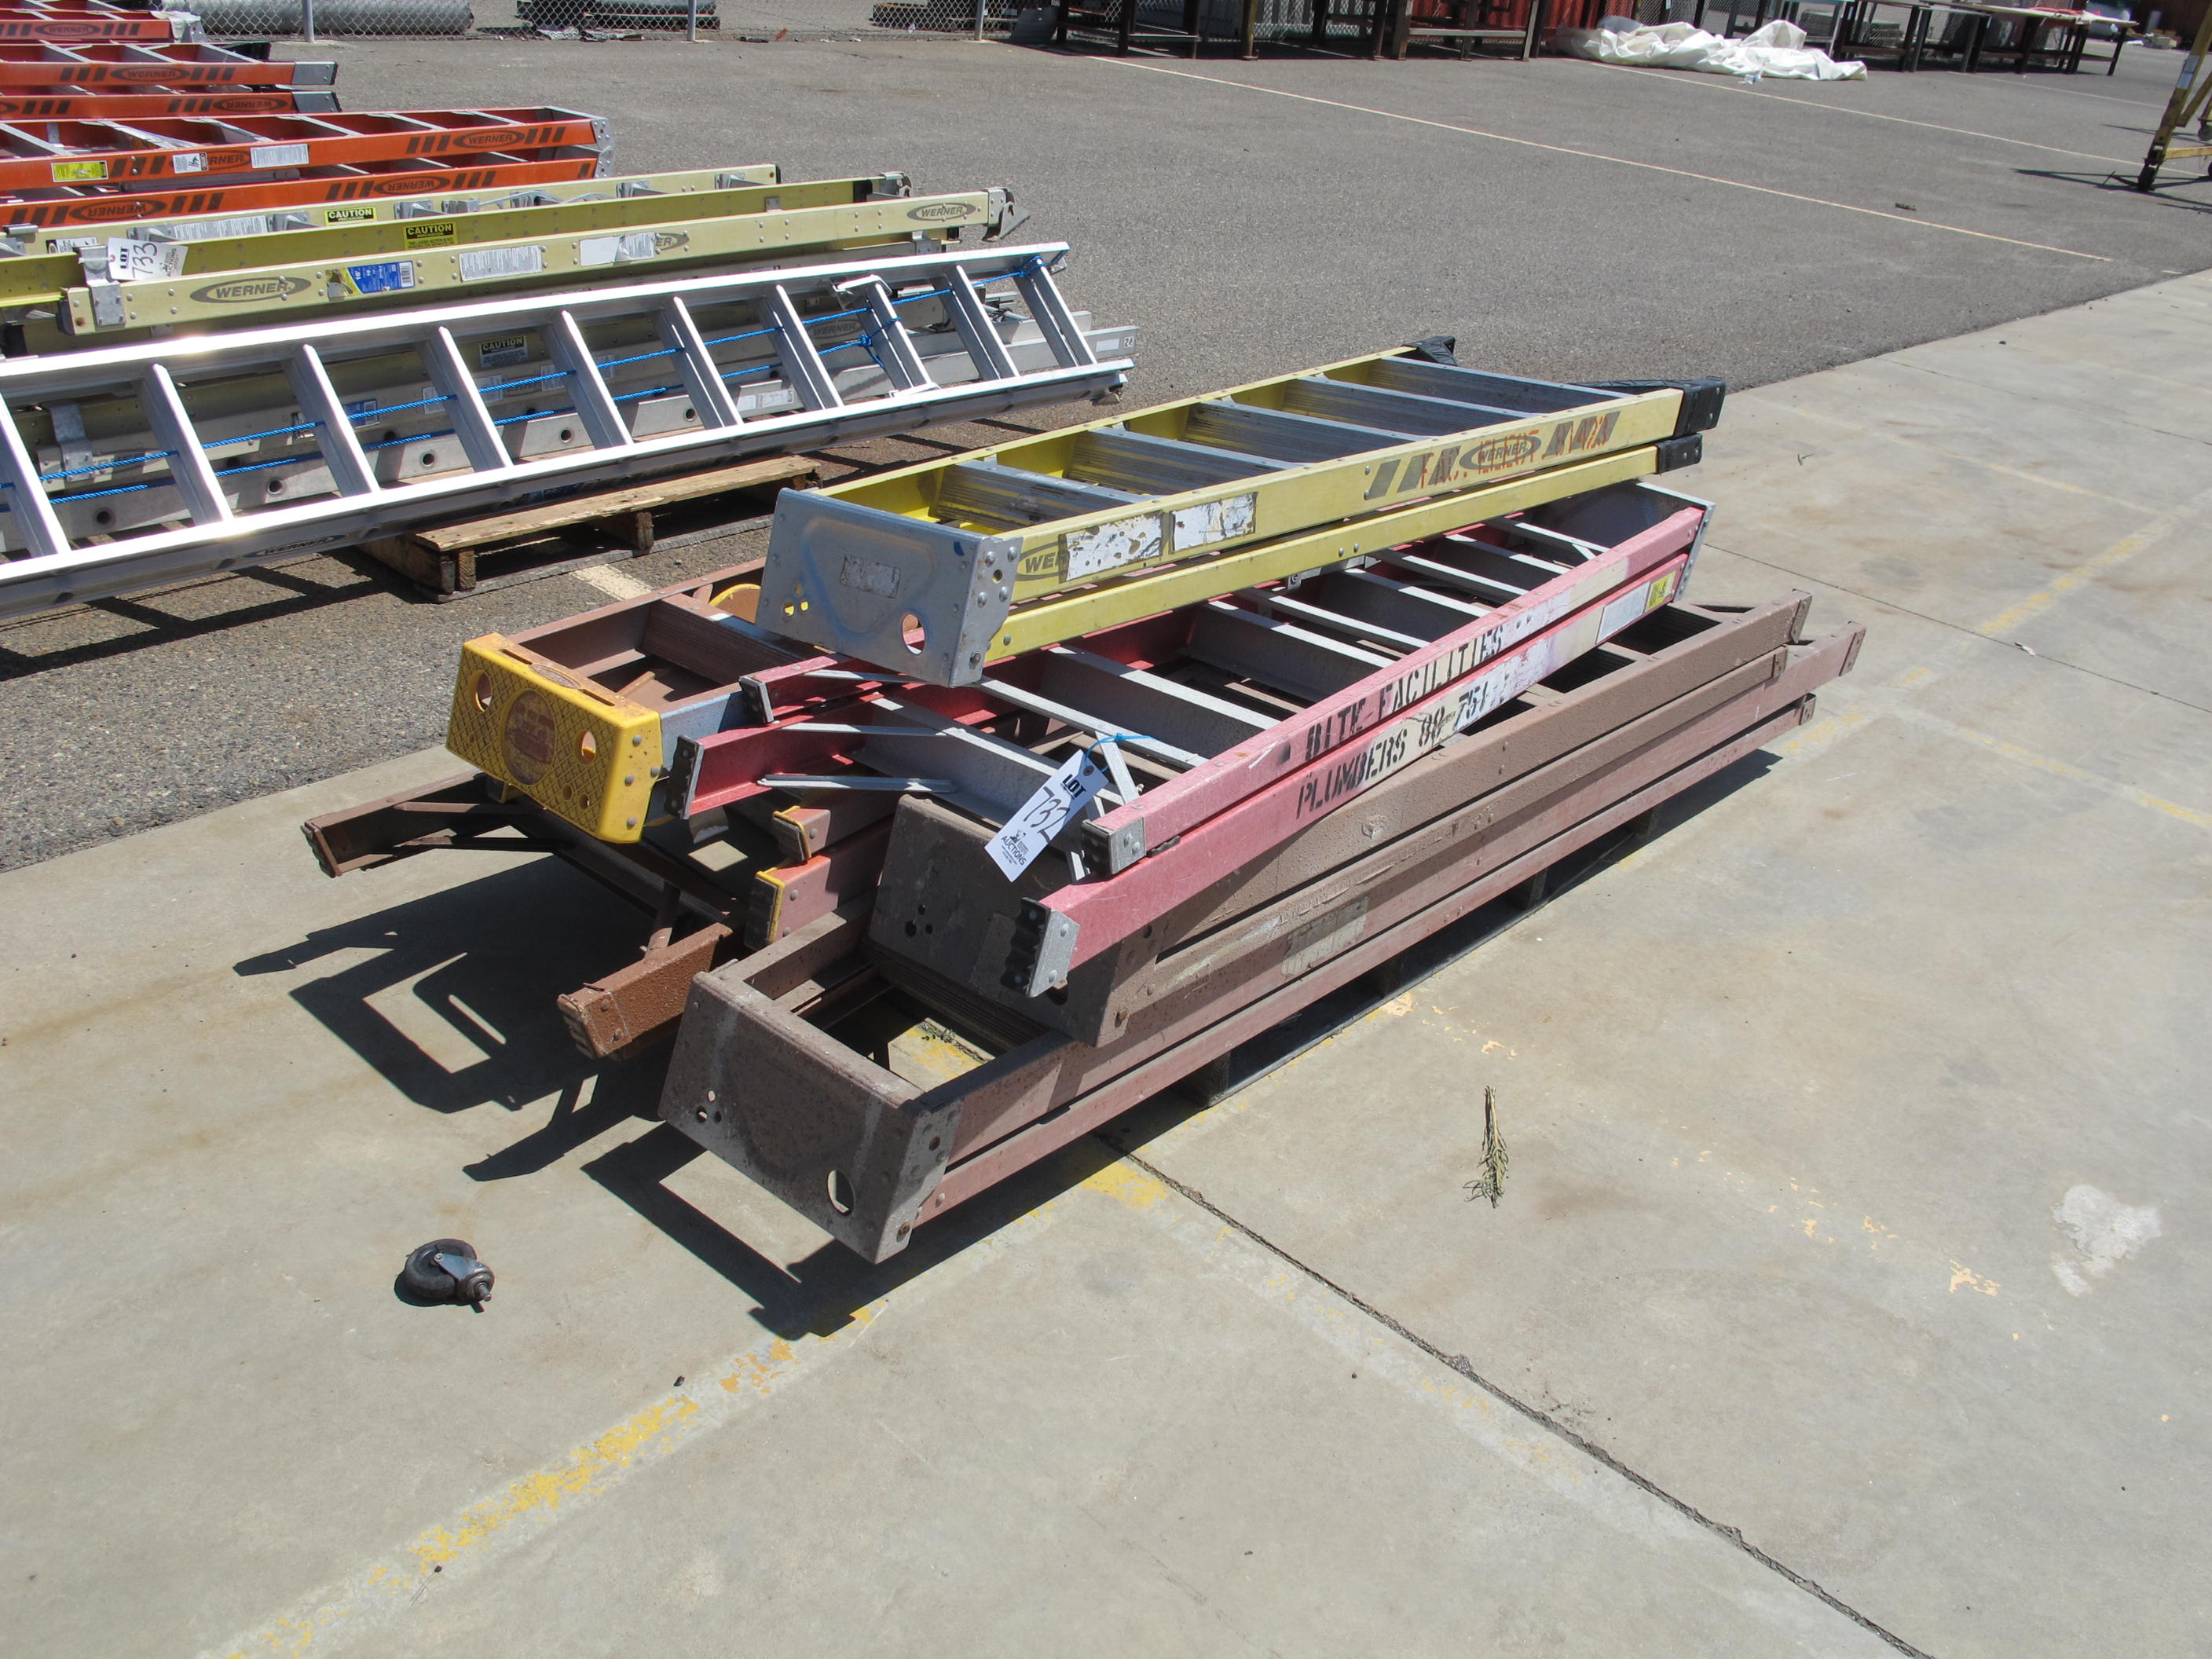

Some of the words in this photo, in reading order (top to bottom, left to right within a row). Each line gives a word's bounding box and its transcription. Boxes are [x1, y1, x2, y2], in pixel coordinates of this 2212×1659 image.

[127, 68, 177, 78] WERNER
[225, 100, 273, 109] WERNER
[467, 134, 513, 145] WERNER
[388, 180, 434, 192] WERNER
[88, 203, 147, 217] WERNER
[328, 208, 372, 219] CAUTION
[921, 206, 963, 218] WERNER
[407, 223, 452, 236] CAUTION
[132, 242, 158, 279] 733
[215, 278, 291, 299] WERNER
[812, 323, 856, 335] WERNER
[482, 337, 523, 351] CAUTION
[1379, 624, 1503, 720] FACILITIES
[1296, 728, 1408, 820] PLUMBERS
[1062, 774, 1086, 798] LOT
[1023, 786, 1071, 843] 732
[1001, 835, 1027, 866] AUCTIONS
